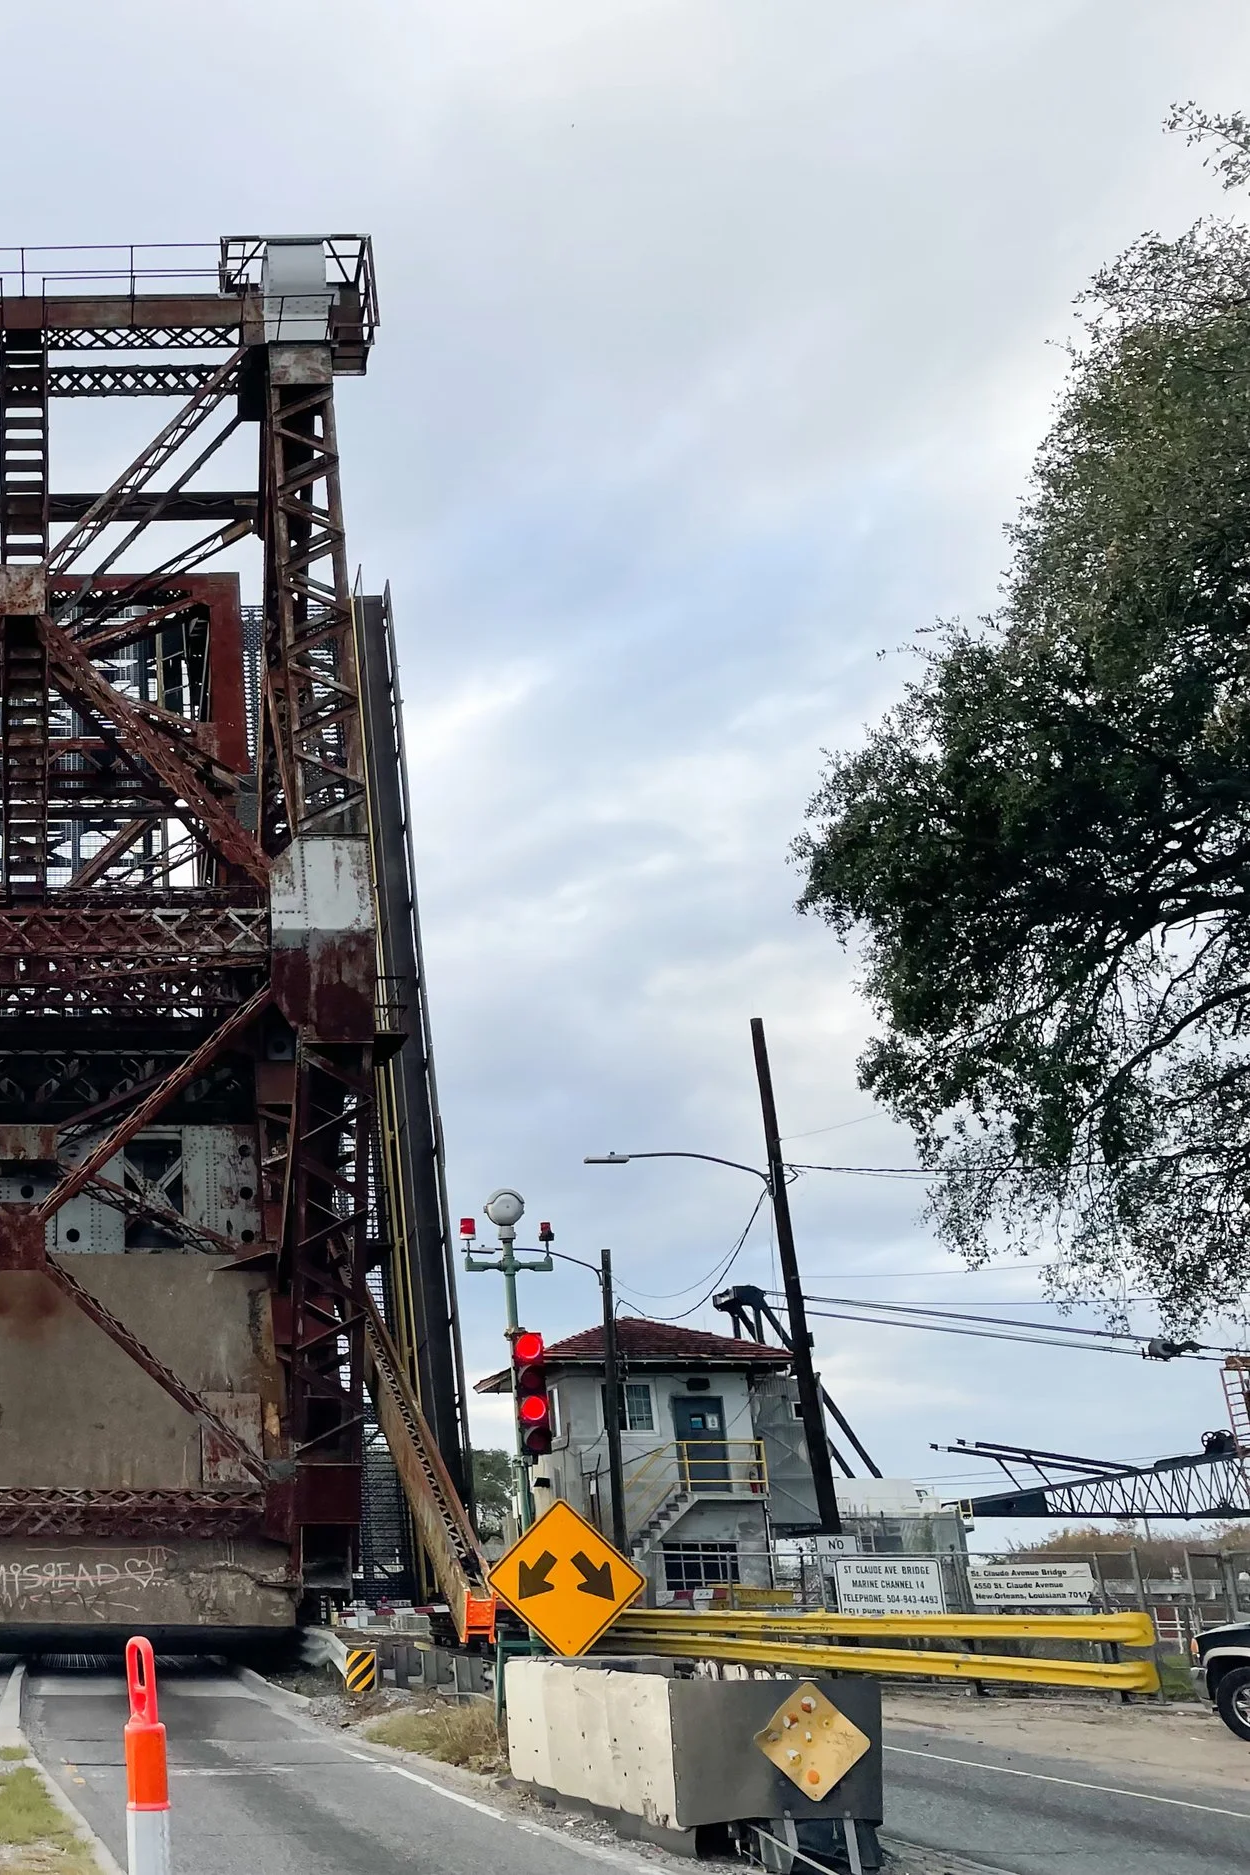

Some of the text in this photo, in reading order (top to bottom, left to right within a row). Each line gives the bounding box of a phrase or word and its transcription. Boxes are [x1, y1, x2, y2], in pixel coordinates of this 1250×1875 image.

[828, 1540, 844, 1550] NO
[843, 1565, 930, 1575] ST CLAUDE AVE BRIDGE
[1041, 1569, 1067, 1578] Bridge
[851, 1580, 925, 1589] MARINE CHANNEL 14
